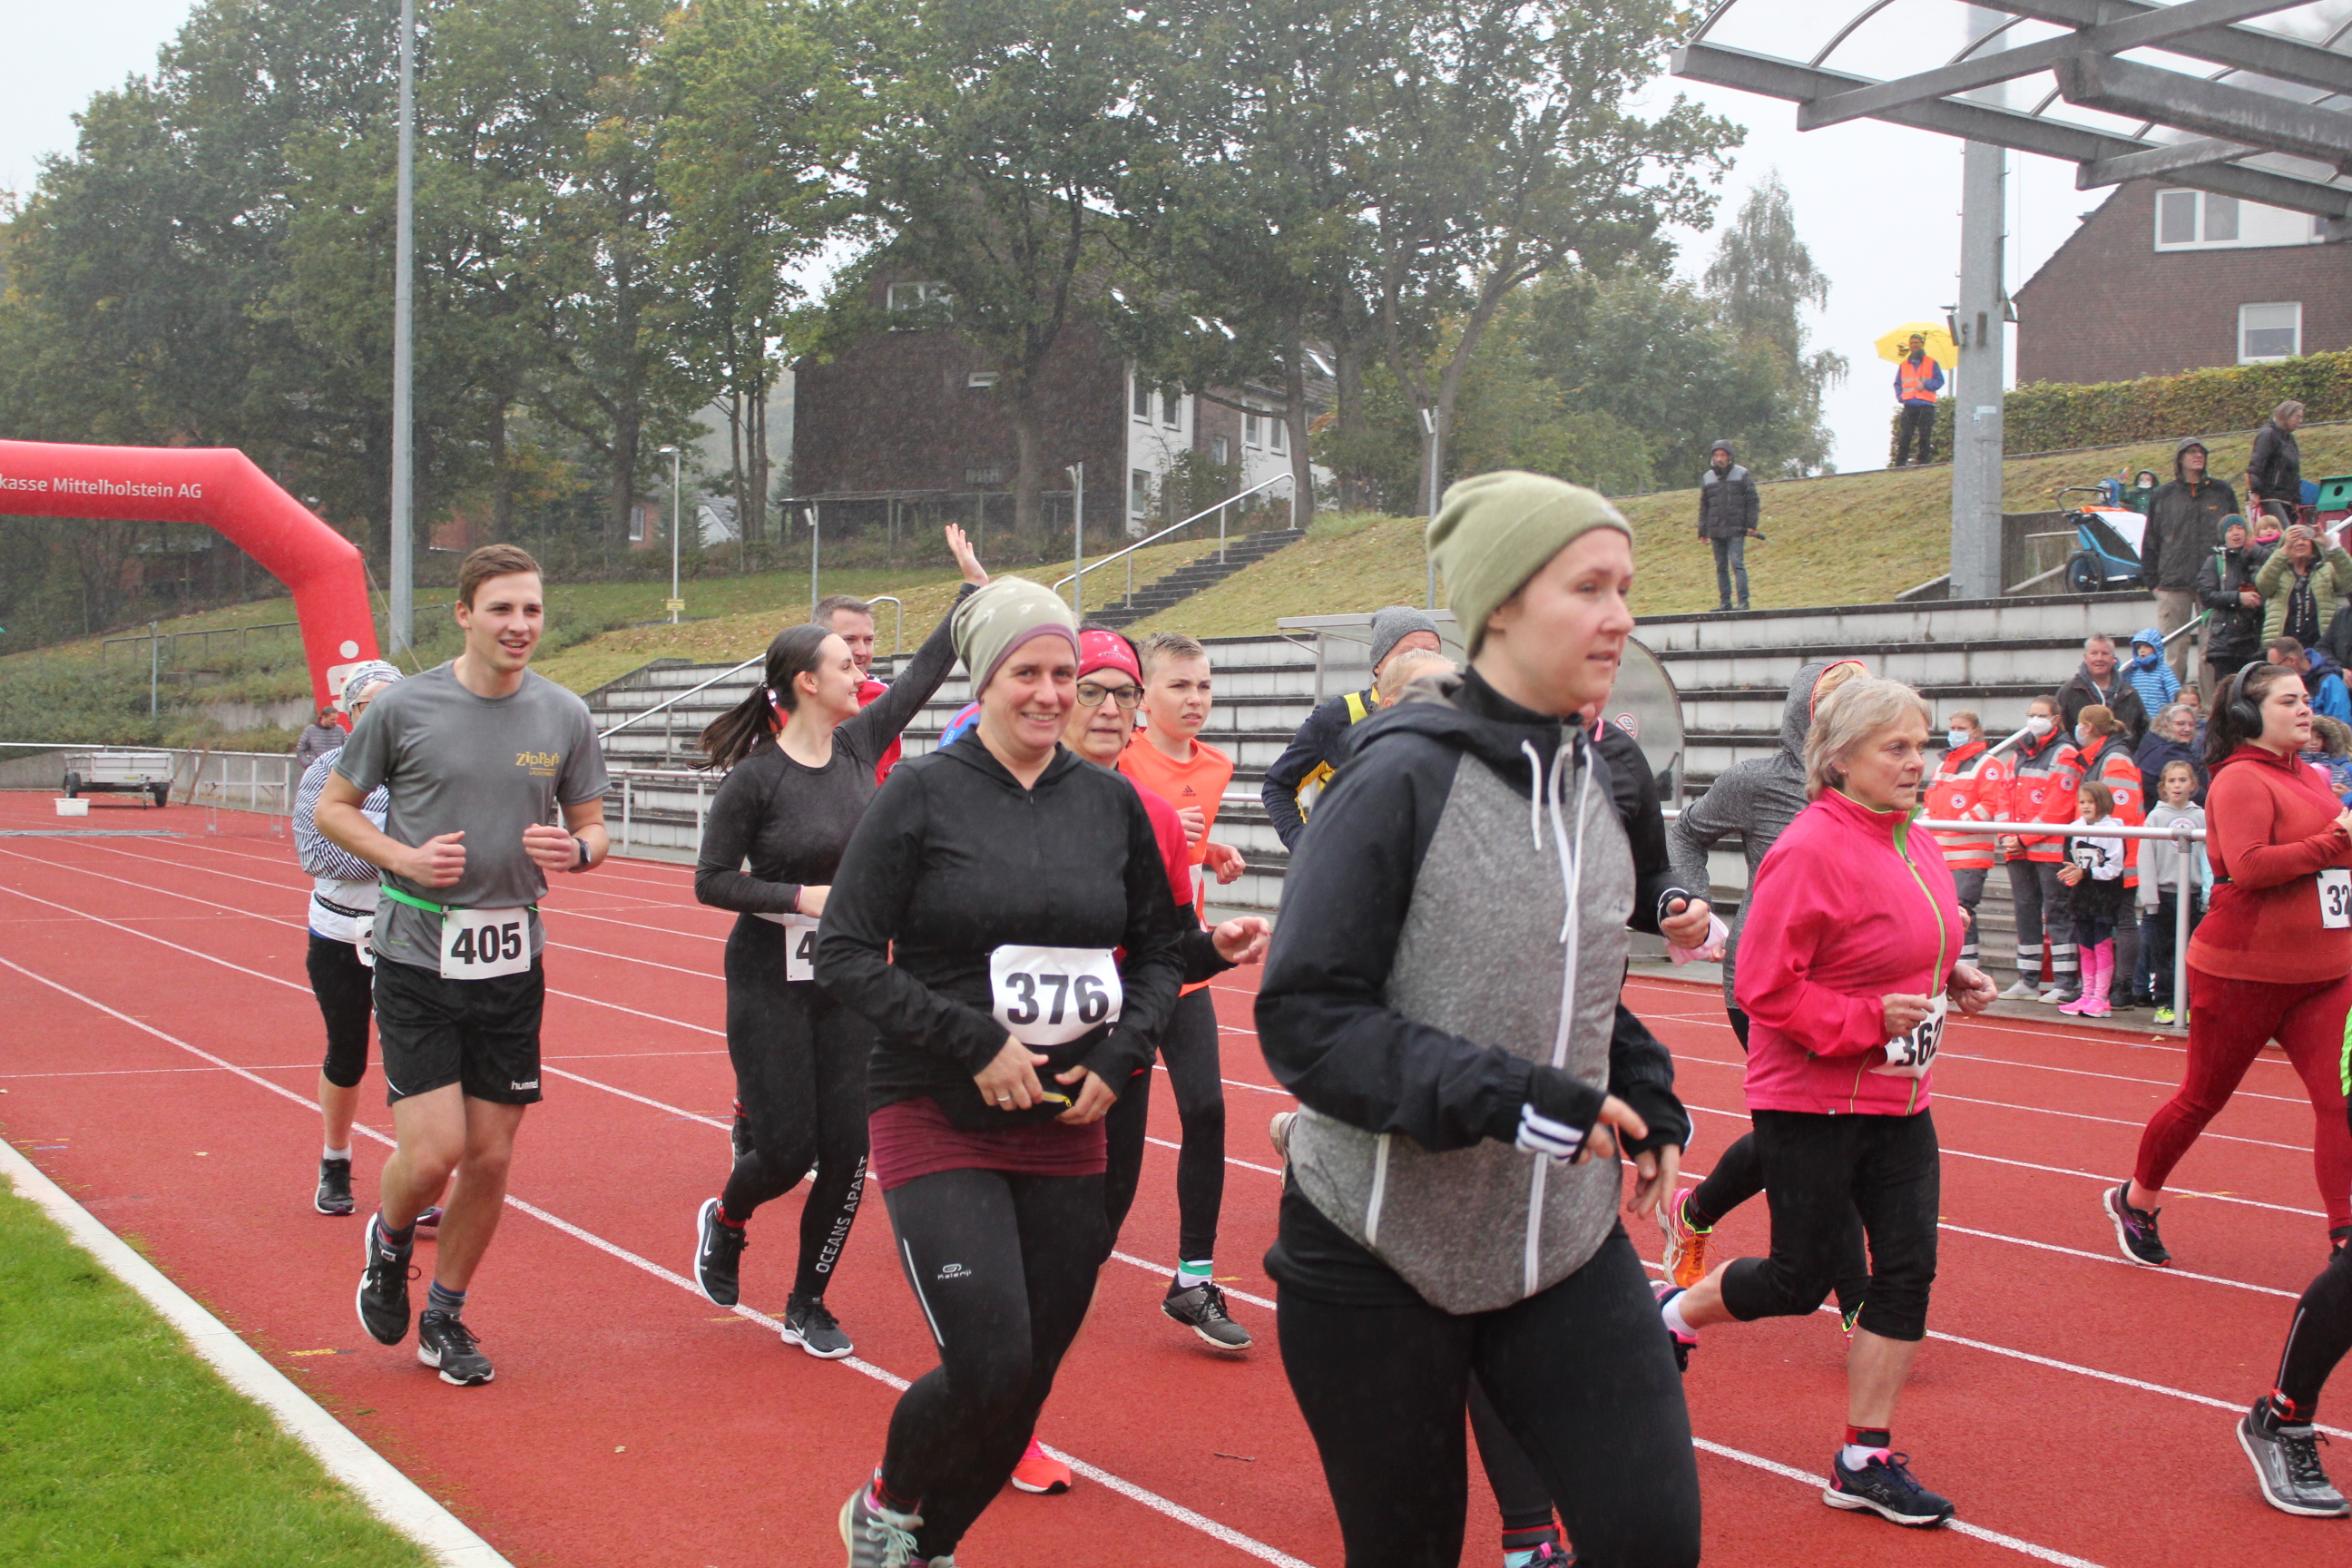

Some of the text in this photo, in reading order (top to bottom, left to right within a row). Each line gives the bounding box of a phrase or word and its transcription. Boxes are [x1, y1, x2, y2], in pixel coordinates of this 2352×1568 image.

[53, 477, 173, 497] Mittelholstein
[178, 483, 202, 498] AG
[451, 922, 522, 965] 405
[1005, 972, 1109, 1024] 376
[1891, 1015, 1943, 1066] 362
[816, 1156, 867, 1273] OCEANS APART
